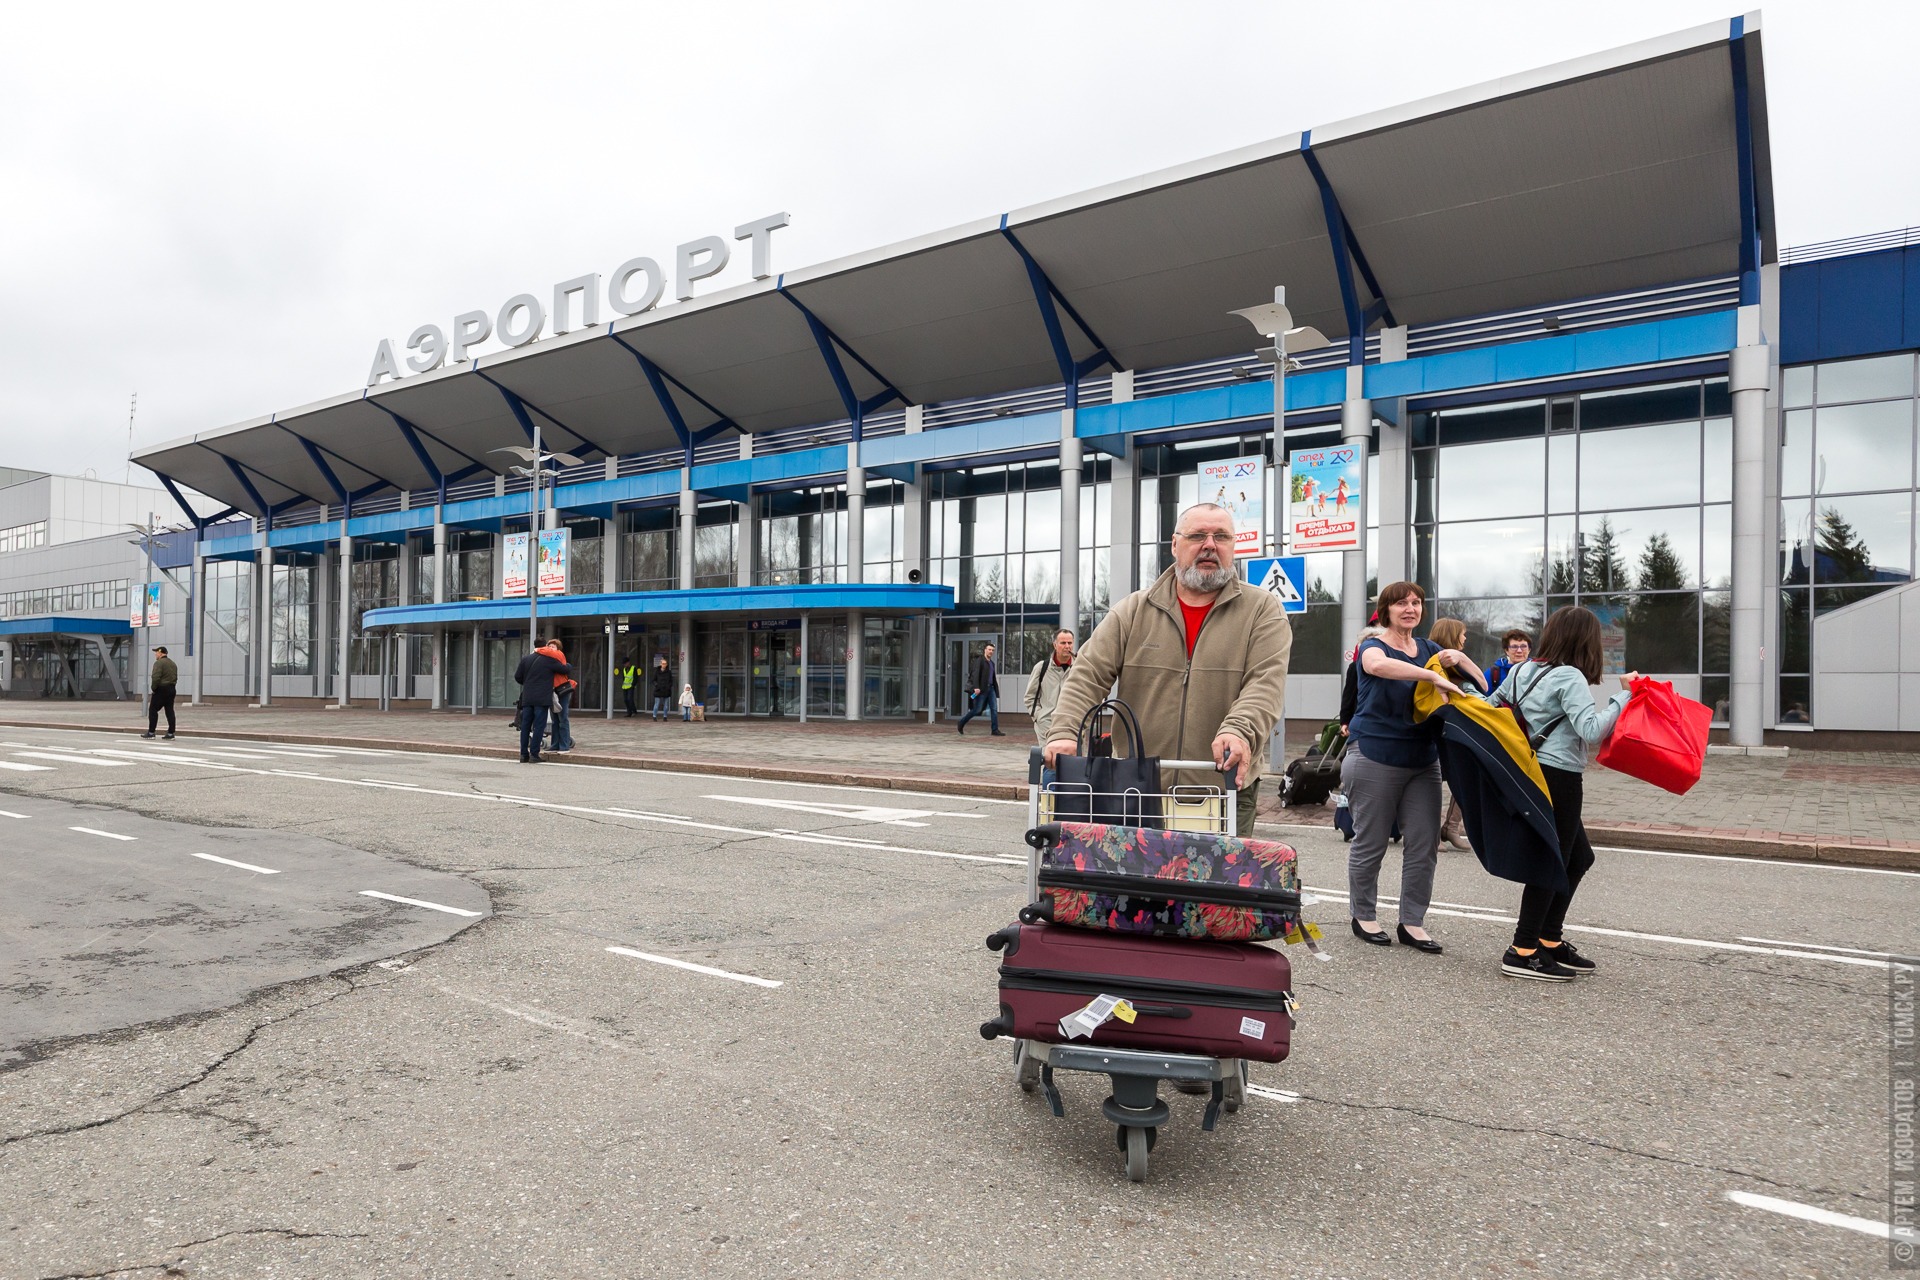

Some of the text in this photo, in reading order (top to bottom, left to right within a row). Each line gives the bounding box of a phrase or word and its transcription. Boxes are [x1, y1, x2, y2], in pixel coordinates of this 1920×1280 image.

[367, 211, 790, 386] АЭРОПОРТ
[1298, 453, 1324, 462] anex
[1205, 465, 1229, 475] anex
[1298, 520, 1326, 531] ВРЕМЯ
[1307, 524, 1352, 535] ОТДЫХАТЬ
